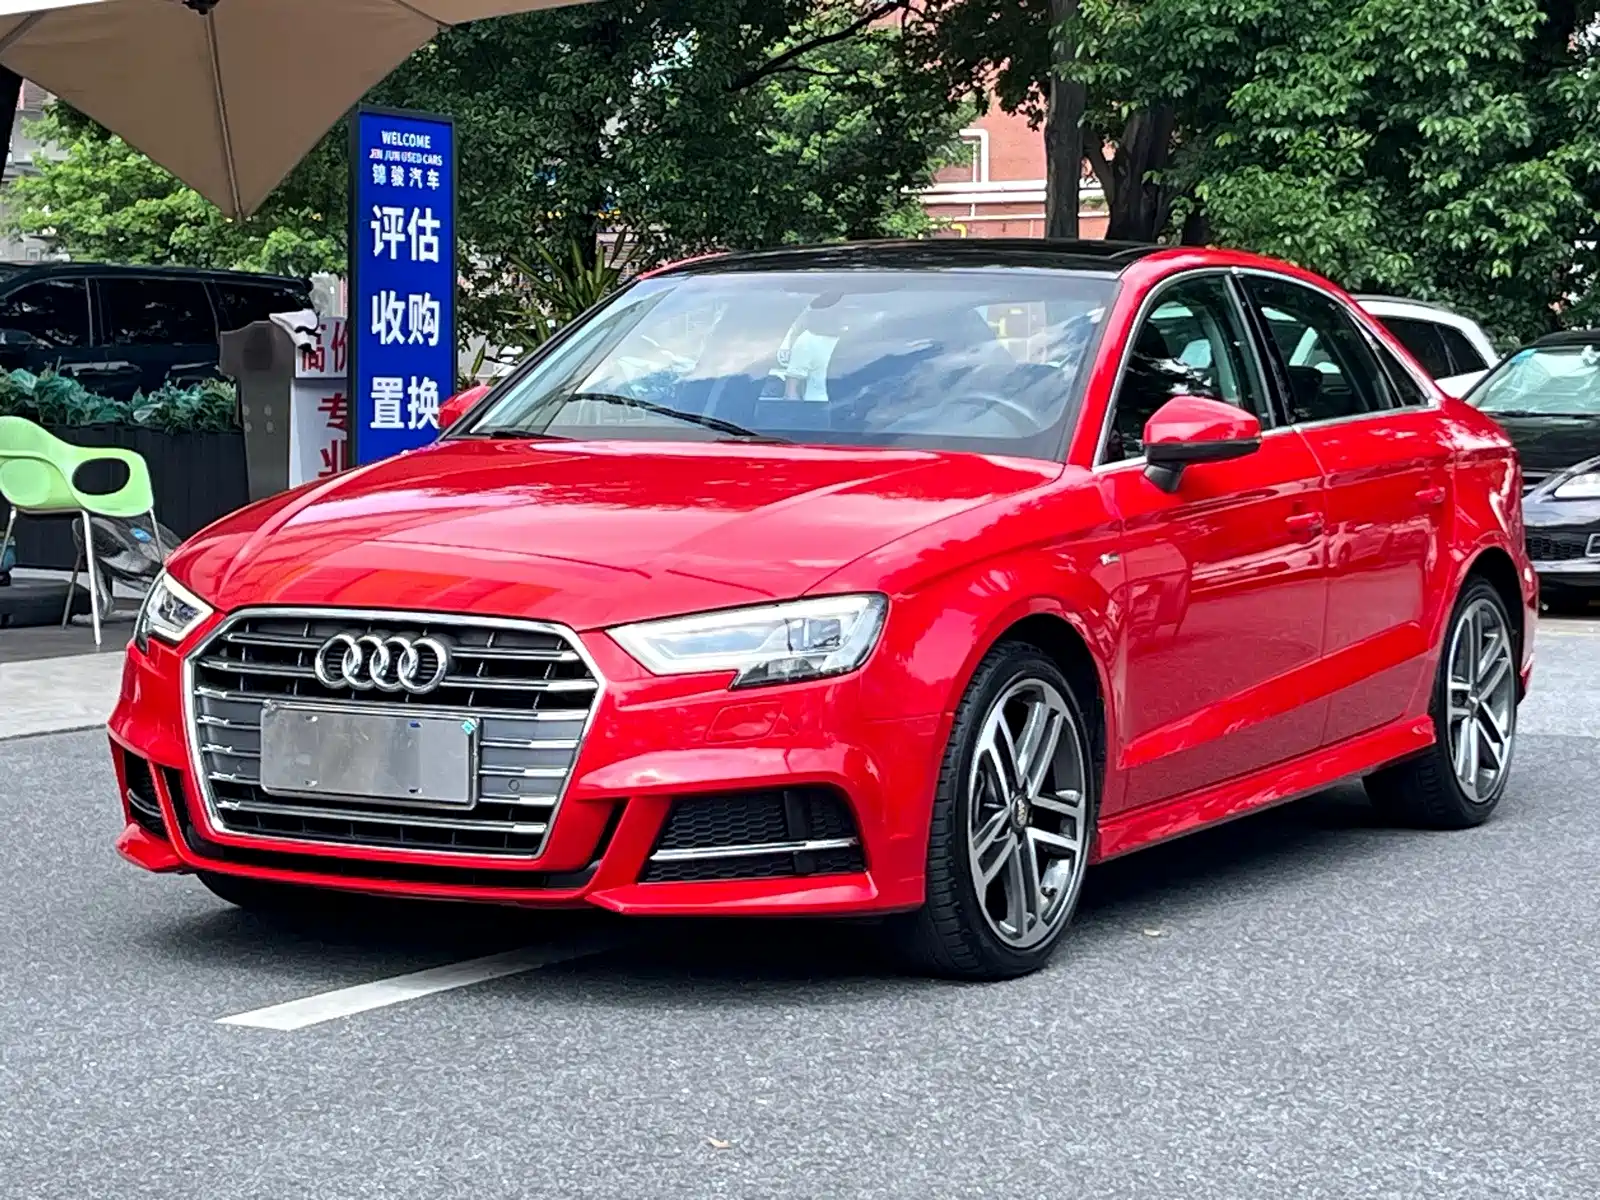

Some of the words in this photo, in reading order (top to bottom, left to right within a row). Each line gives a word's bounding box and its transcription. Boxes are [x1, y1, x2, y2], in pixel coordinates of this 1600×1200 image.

[381, 130, 431, 149] WELCOME
[401, 151, 422, 164] USED
[422, 153, 443, 167] CARS
[370, 204, 441, 263] 评估
[371, 290, 441, 347] 收购
[370, 375, 441, 430] 置换
